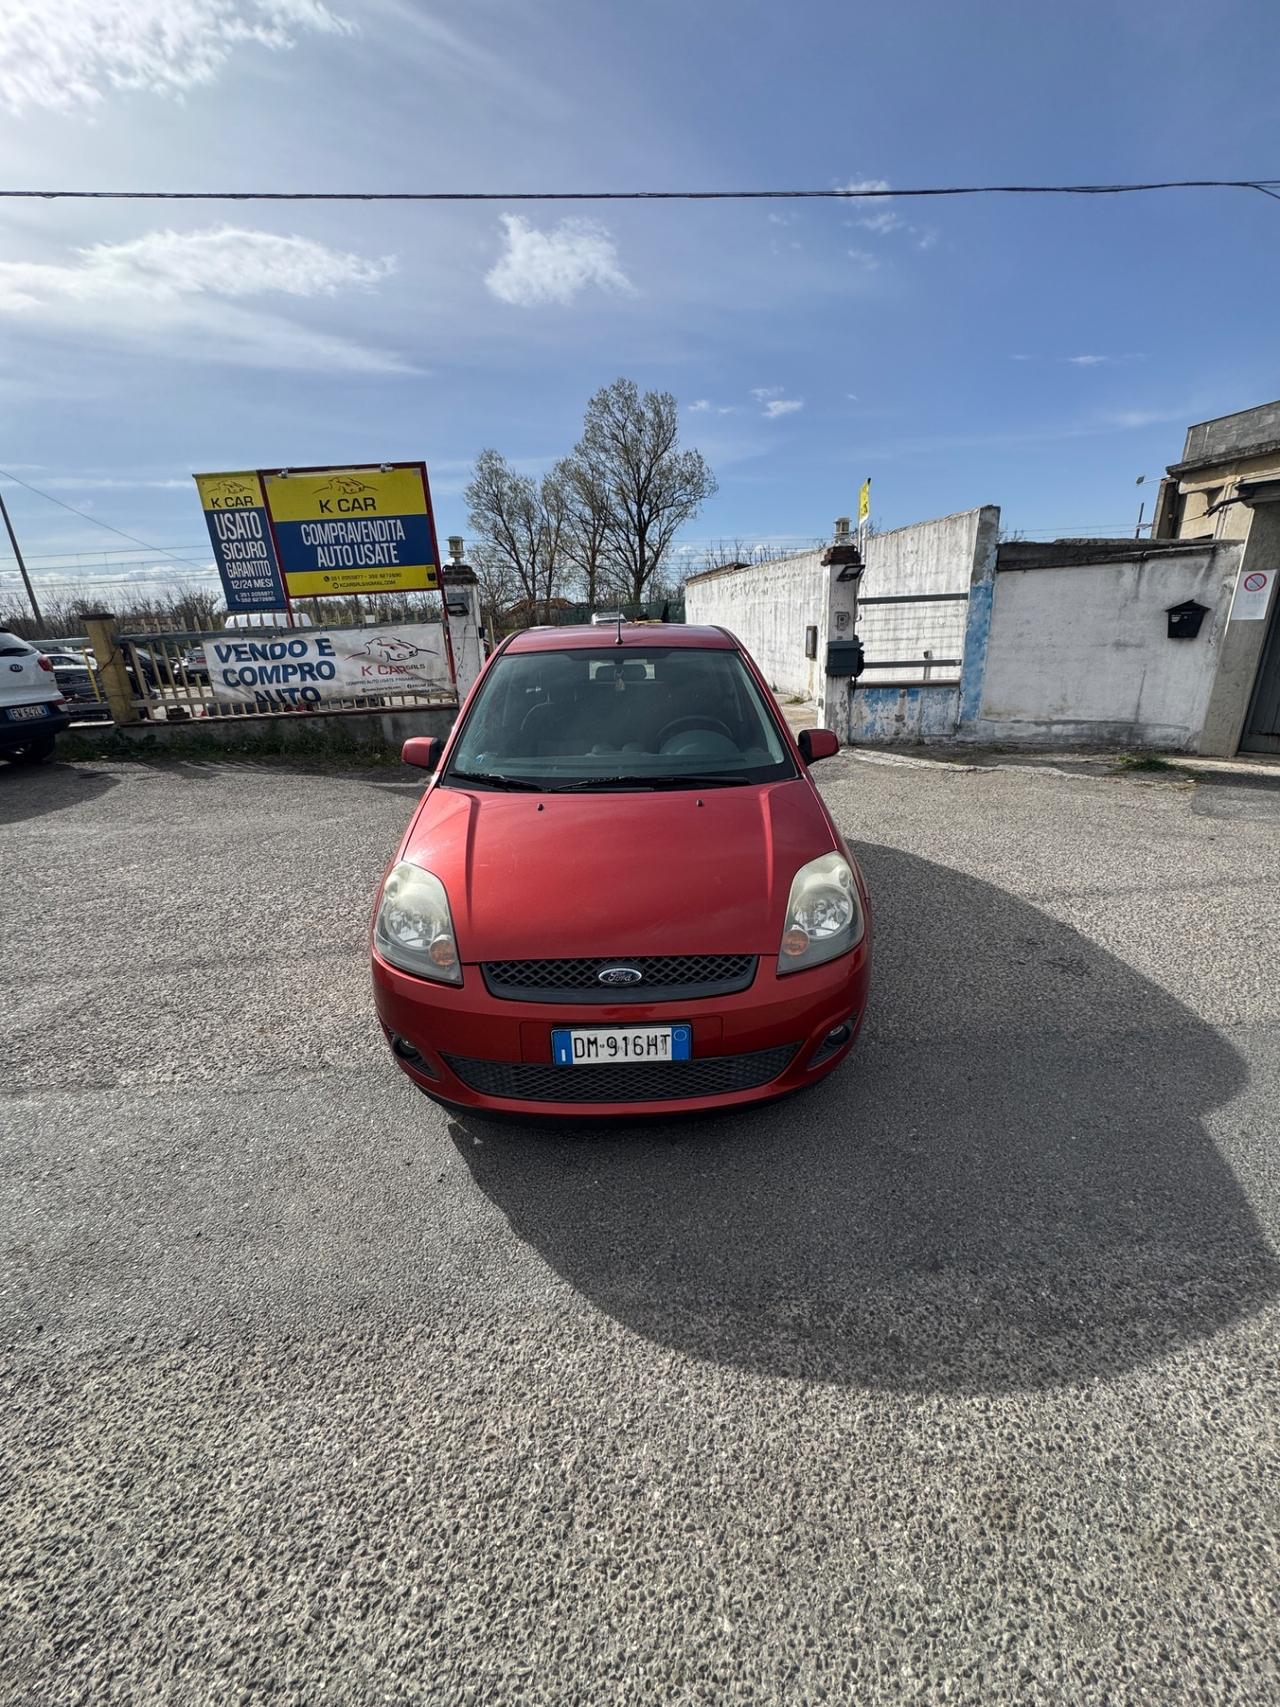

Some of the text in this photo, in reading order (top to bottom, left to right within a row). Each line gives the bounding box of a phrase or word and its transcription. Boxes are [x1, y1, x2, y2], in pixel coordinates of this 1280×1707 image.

[210, 496, 254, 508] K CAR
[319, 497, 377, 513] K CAR
[213, 511, 263, 540] USATO
[300, 519, 406, 545] COMPRAVENDITA
[221, 541, 267, 561] SICURO
[317, 542, 400, 567] AUTO USATE
[225, 560, 272, 579] GARANTITO
[230, 578, 274, 590] 12/24 MESI
[213, 638, 336, 663] VENDO E
[222, 660, 336, 688] COMPRO
[361, 665, 373, 676] K
[378, 664, 406, 676] CAR
[254, 686, 322, 705] AUTO
[607, 972, 633, 983] Ford
